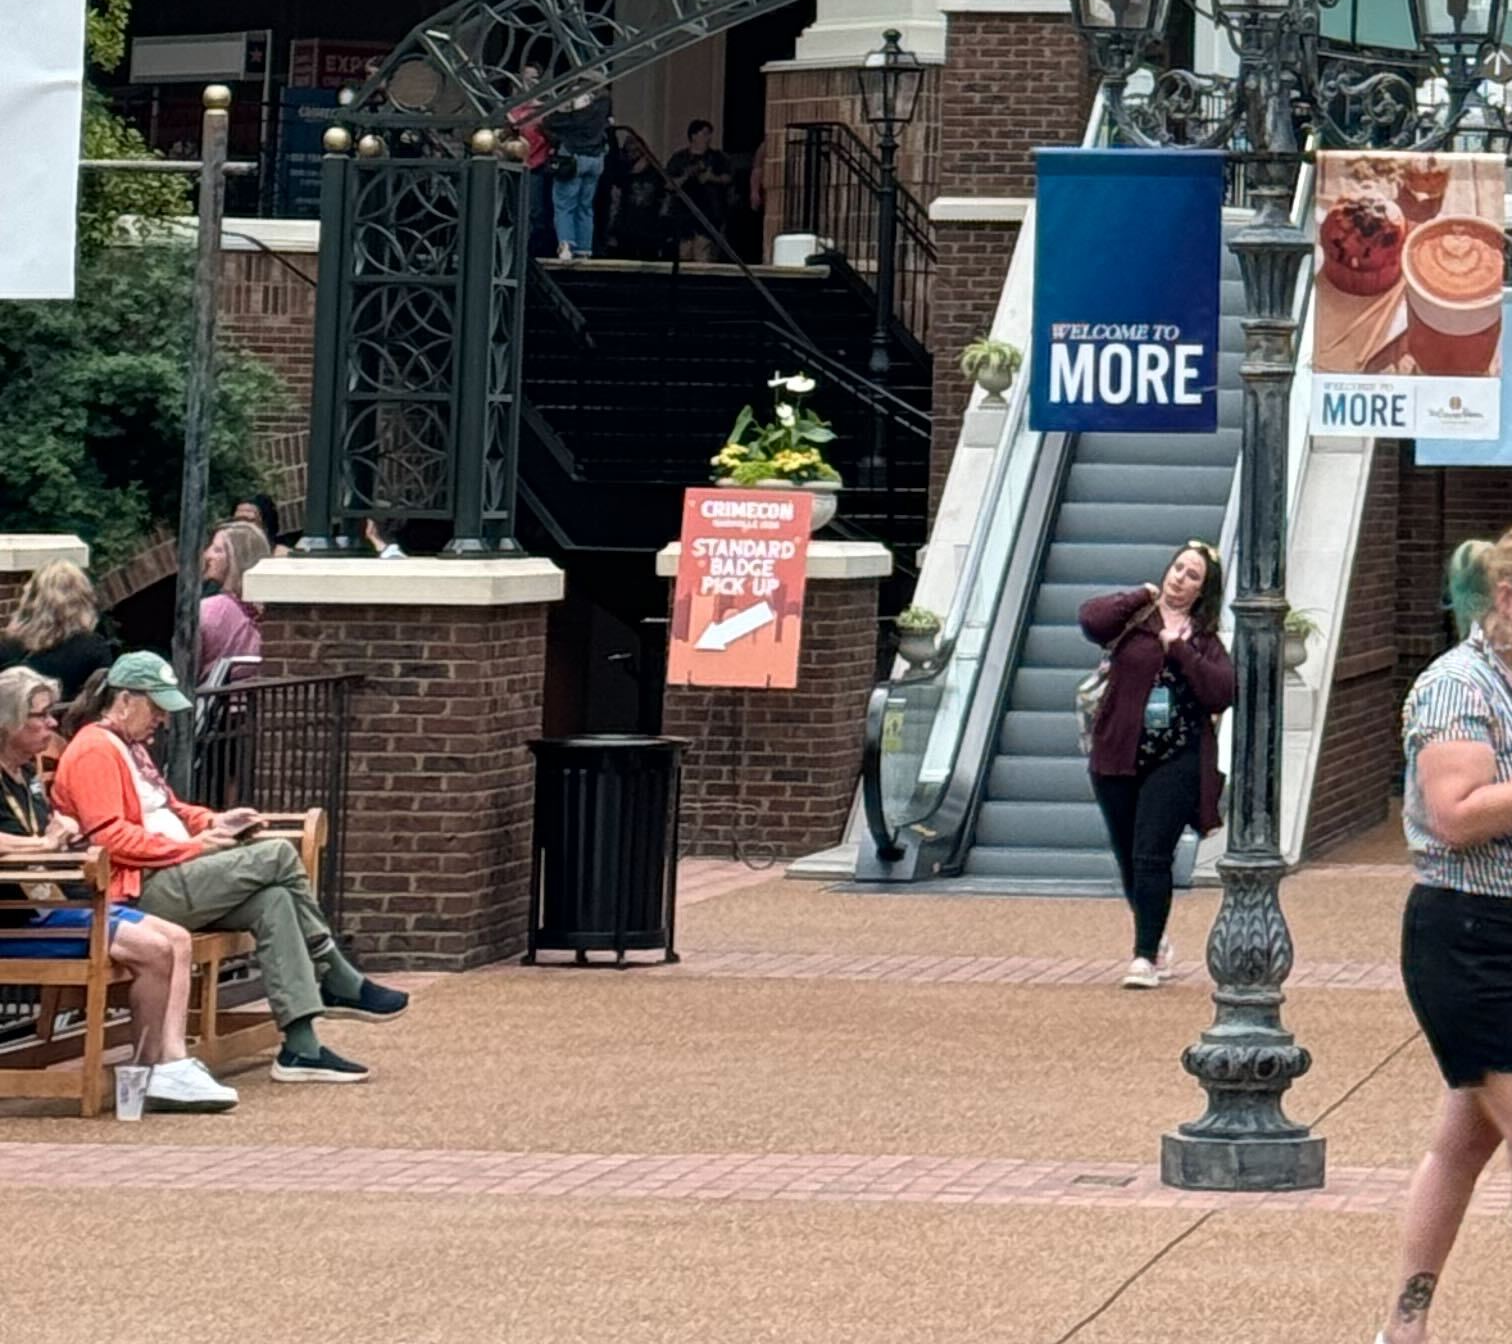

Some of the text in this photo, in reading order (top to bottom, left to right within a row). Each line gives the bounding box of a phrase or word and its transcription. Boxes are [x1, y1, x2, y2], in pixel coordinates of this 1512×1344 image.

[1052, 322, 1181, 341] WELCOME TO
[1050, 342, 1203, 405] MORE
[1322, 392, 1407, 428] MORE
[700, 499, 794, 521] CRIMECON
[692, 537, 795, 560] STANDARD
[709, 557, 776, 577] BADGE
[700, 576, 780, 597] PICK UP
